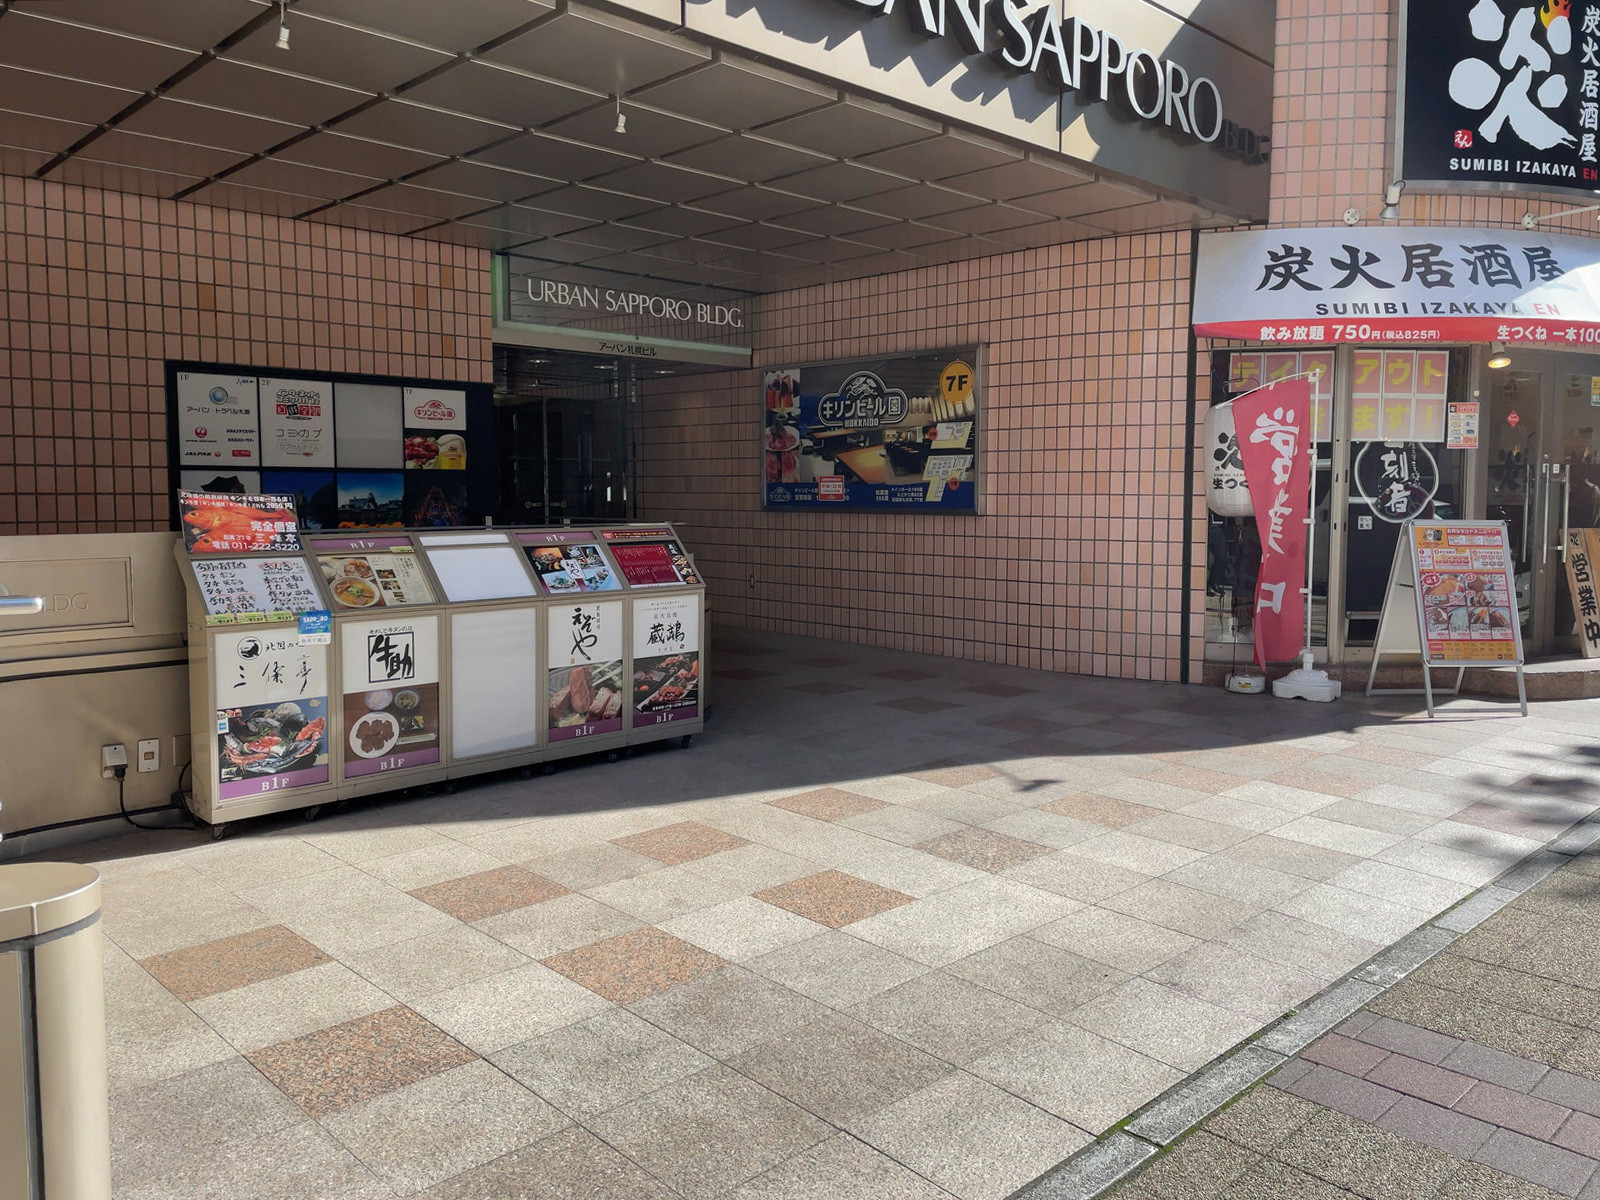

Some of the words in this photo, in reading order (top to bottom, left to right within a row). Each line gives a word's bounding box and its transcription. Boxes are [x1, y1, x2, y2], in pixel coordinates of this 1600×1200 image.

[1001, 0, 1223, 142] SAPPORO
[1449, 157, 1509, 172] SUMIBI
[1516, 161, 1577, 178] IZAKAYA
[1583, 167, 1599, 182] EN
[1254, 243, 1577, 296] 炭火居酒屋
[527, 278, 600, 311] URBAN
[605, 289, 692, 323] SAPPORO
[697, 302, 745, 331] BLDG.
[1315, 302, 1409, 315] SUMIBI
[1421, 302, 1520, 315] IZAKAYA
[1534, 303, 1562, 316] EN
[1260, 327, 1325, 346] 飲み放題
[1497, 325, 1547, 341] 生つくね
[598, 341, 657, 360] アーバン札幌ビル
[1355, 359, 1444, 388] アウト
[945, 374, 968, 392] 7F
[822, 396, 901, 421] キリンビール園
[844, 418, 879, 429] HOKKAIDO
[250, 520, 298, 533] 完全個室
[231, 541, 300, 552] 011-222-5220
[1571, 553, 1600, 649] 営業中
[369, 634, 413, 679] 牛助
[656, 711, 674, 724] B1F
[575, 724, 595, 737] B1F
[380, 757, 406, 771] B1F
[261, 776, 290, 791] B1F
